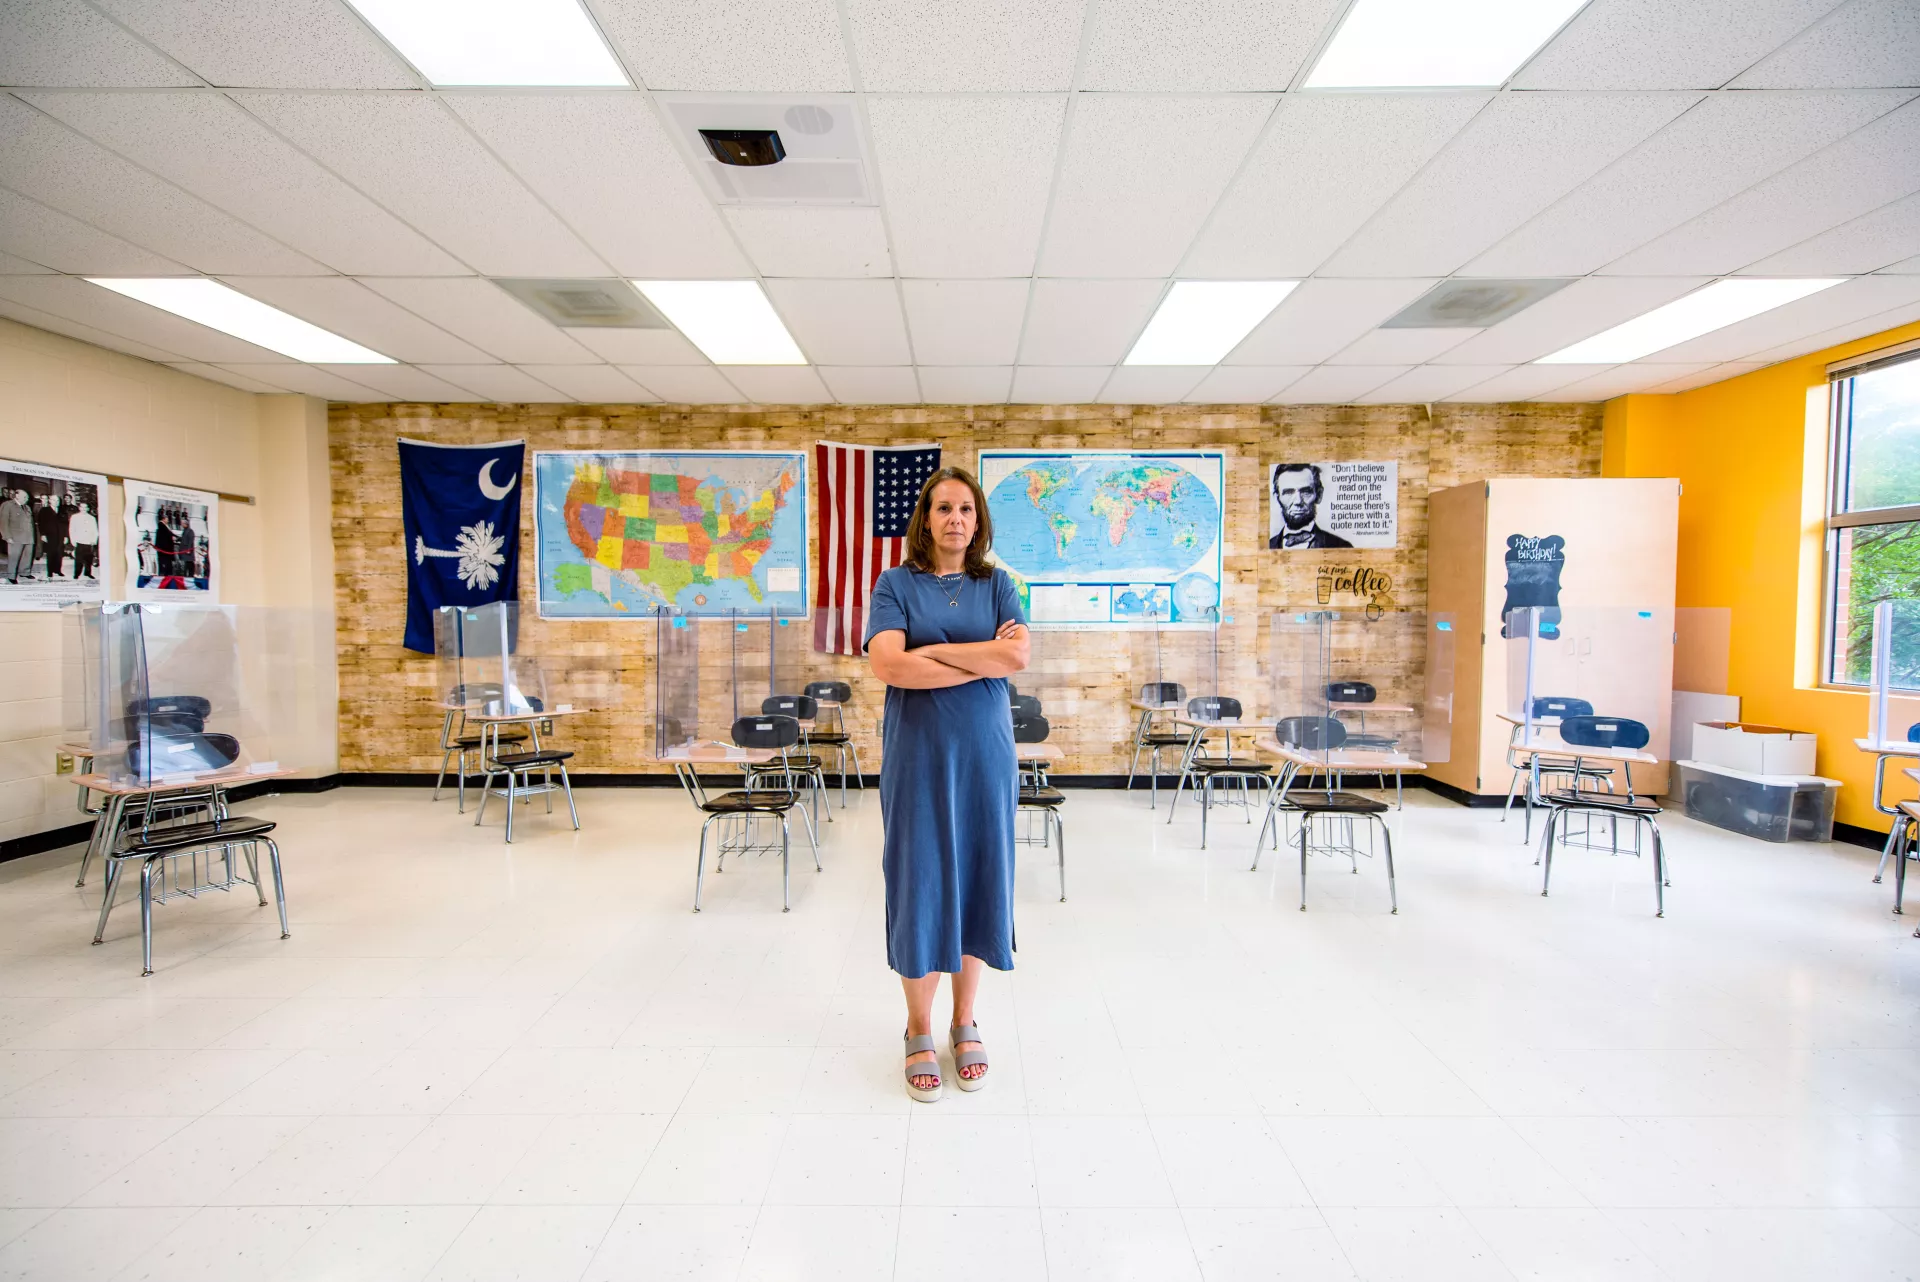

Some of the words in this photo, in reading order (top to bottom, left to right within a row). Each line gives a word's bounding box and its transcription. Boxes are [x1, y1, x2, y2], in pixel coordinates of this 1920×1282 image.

[1357, 464, 1385, 473] believe
[1331, 474, 1372, 484] everything
[1373, 474, 1388, 483] you
[1339, 483, 1356, 491] read
[1369, 483, 1382, 491] the
[1336, 492, 1366, 501] internet
[1367, 492, 1382, 503] just
[1330, 502, 1362, 511] because
[1364, 501, 1390, 510] there's
[1337, 511, 1365, 521] picture
[1366, 511, 1383, 519] with
[1330, 521, 1353, 531] quote
[1354, 521, 1371, 529] next
[1372, 521, 1381, 529] to
[1515, 537, 1541, 550] HAPPY
[1517, 543, 1557, 562] BIRTHDAY!
[1335, 567, 1388, 597] coffee
